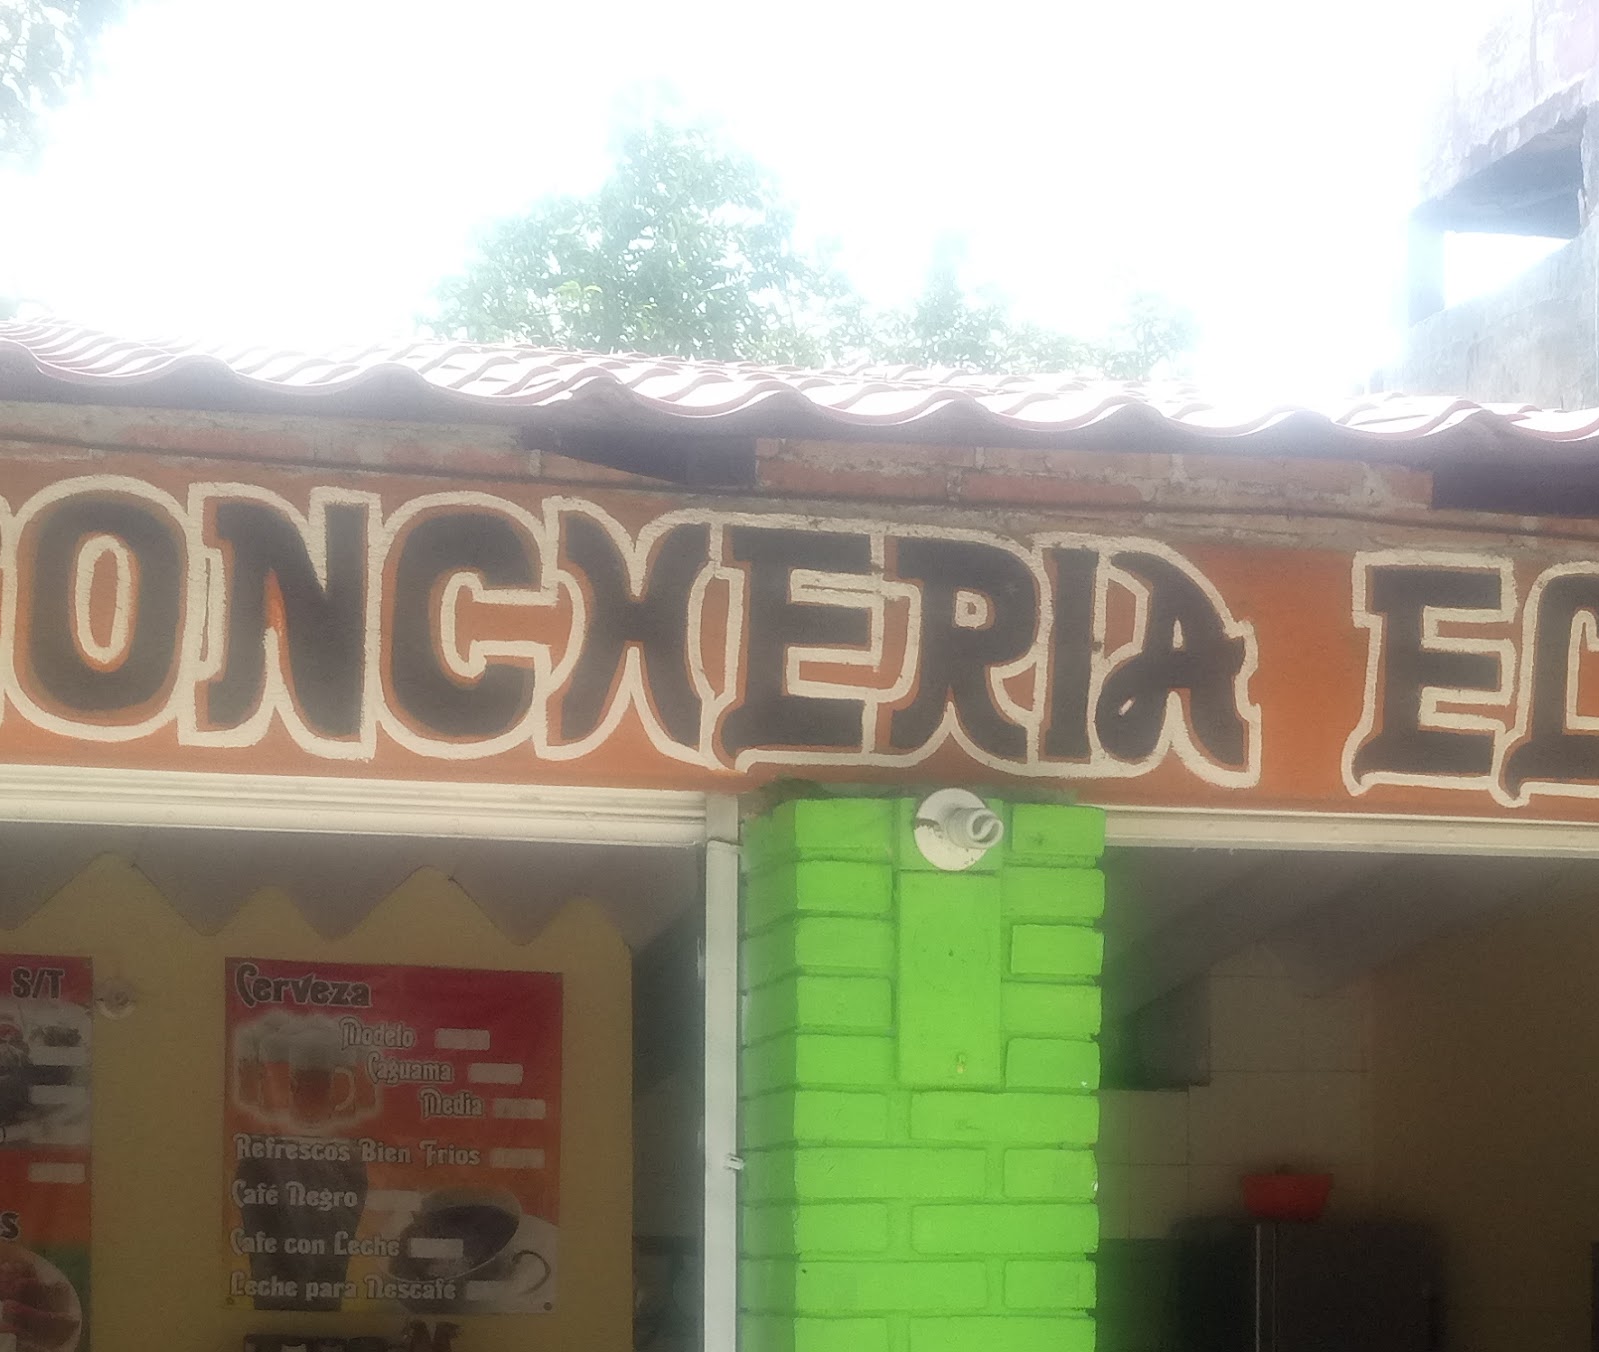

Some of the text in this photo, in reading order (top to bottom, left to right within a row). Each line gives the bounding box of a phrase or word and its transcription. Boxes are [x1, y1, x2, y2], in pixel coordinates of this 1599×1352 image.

[12, 967, 65, 999] S/T
[235, 962, 374, 1008] Cerveza
[340, 1016, 416, 1051] Modelo
[366, 1051, 454, 1086] Caguama
[420, 1088, 484, 1119] Media
[233, 1133, 350, 1162] Refrescos
[360, 1139, 411, 1165] Bien
[231, 1178, 358, 1211] Café Negro
[284, 1237, 326, 1256] con
[334, 1231, 400, 1258] Leche
[230, 1271, 299, 1297] Leche
[305, 1279, 359, 1301] para
